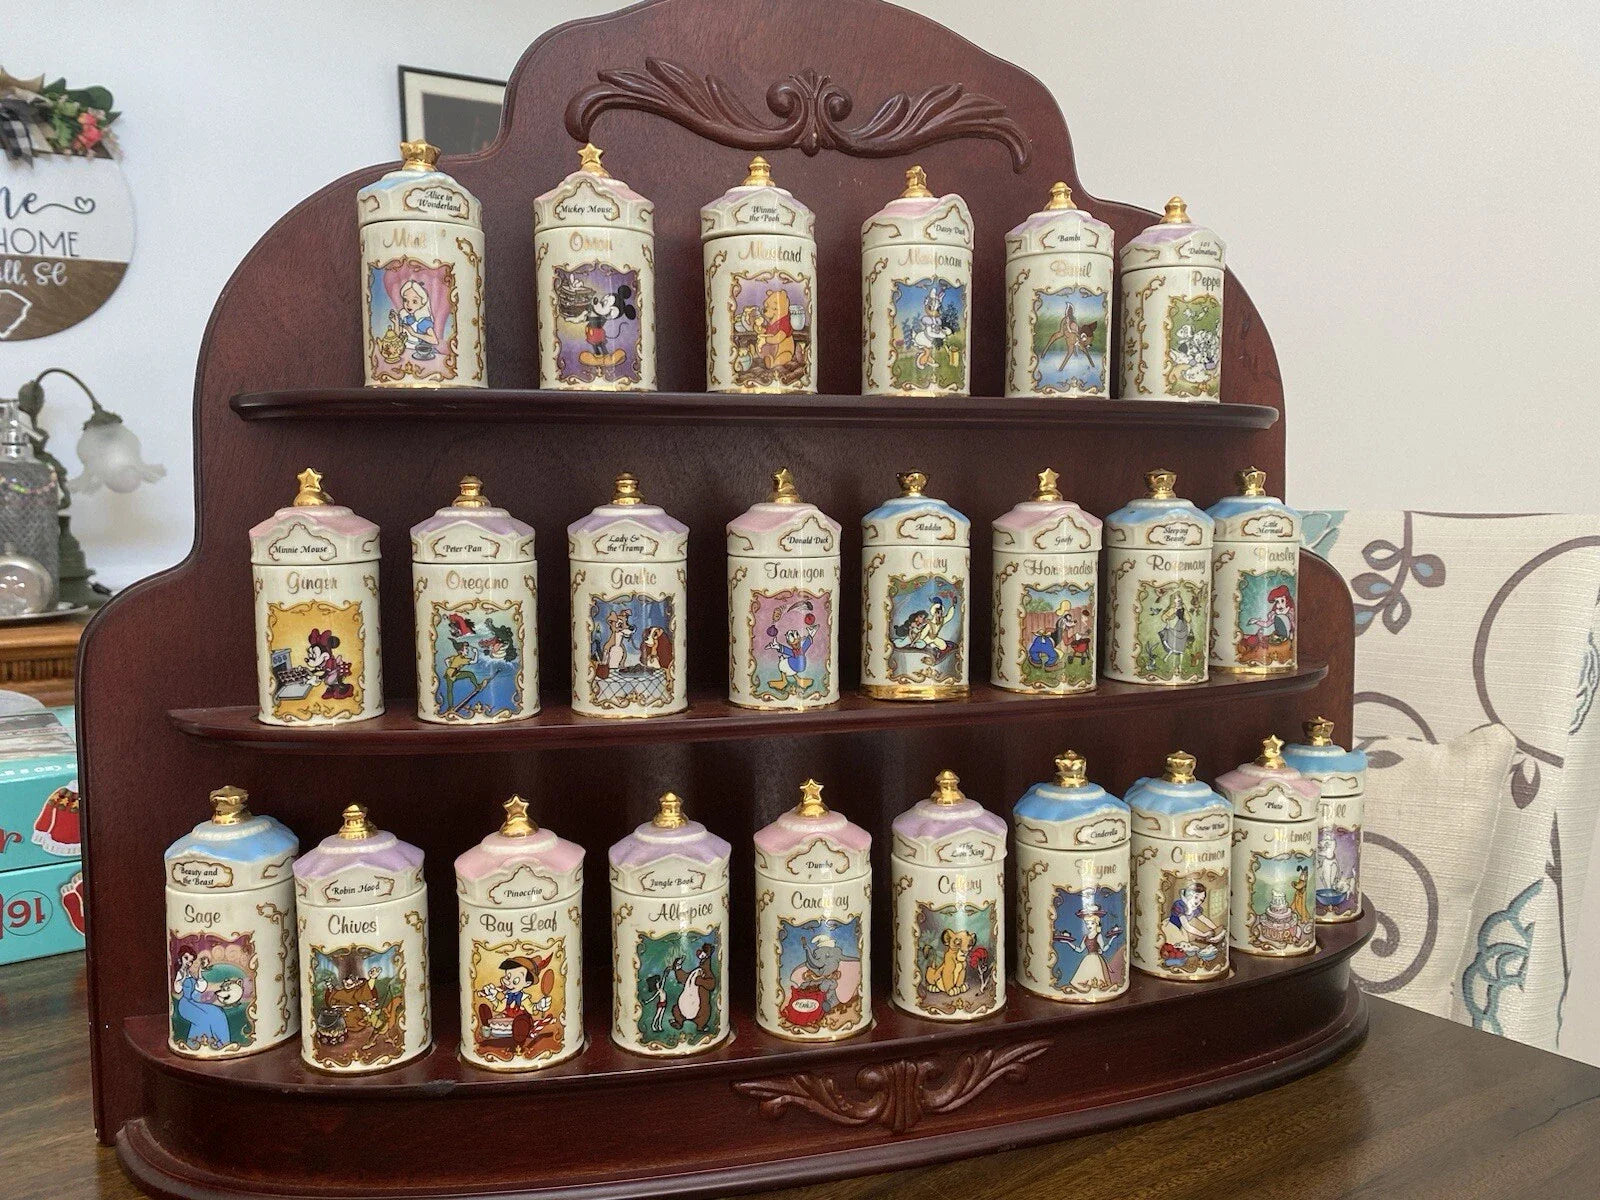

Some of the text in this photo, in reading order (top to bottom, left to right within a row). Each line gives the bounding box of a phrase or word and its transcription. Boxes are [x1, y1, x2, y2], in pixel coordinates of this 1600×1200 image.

[425, 189, 453, 202] Alice in
[417, 198, 462, 213] Wonderland
[558, 203, 613, 215] Mickey Mouse
[751, 206, 777, 214] Winnie
[749, 214, 780, 222] the Pooh
[738, 240, 802, 263] Mustard
[1192, 270, 1221, 291] Peppe
[915, 523, 942, 531] Aladdin
[1163, 526, 1189, 535] Sleeping
[608, 534, 629, 543] Lady
[787, 536, 829, 545] Donald Duck
[1054, 534, 1074, 545] Goofy
[272, 545, 328, 554] Minnie Mouse
[443, 544, 482, 553] Peter Pan
[607, 544, 645, 553] the Tramp
[1023, 559, 1094, 577] Horradis
[286, 571, 338, 595] Ginger
[445, 570, 509, 595] Oregano
[1265, 801, 1283, 810] Pluto
[1090, 828, 1118, 839] Cinderella
[968, 848, 985, 857] King
[179, 866, 218, 877] Beauty and
[182, 877, 214, 886] the Beast
[650, 876, 695, 889] Jungle Book
[331, 881, 380, 895] Robin Hood
[503, 885, 543, 898] Pinocchio
[183, 904, 221, 929] Sage
[648, 902, 714, 924] Allpice
[327, 914, 378, 935] Chives
[479, 910, 558, 938] Bay Leaf
